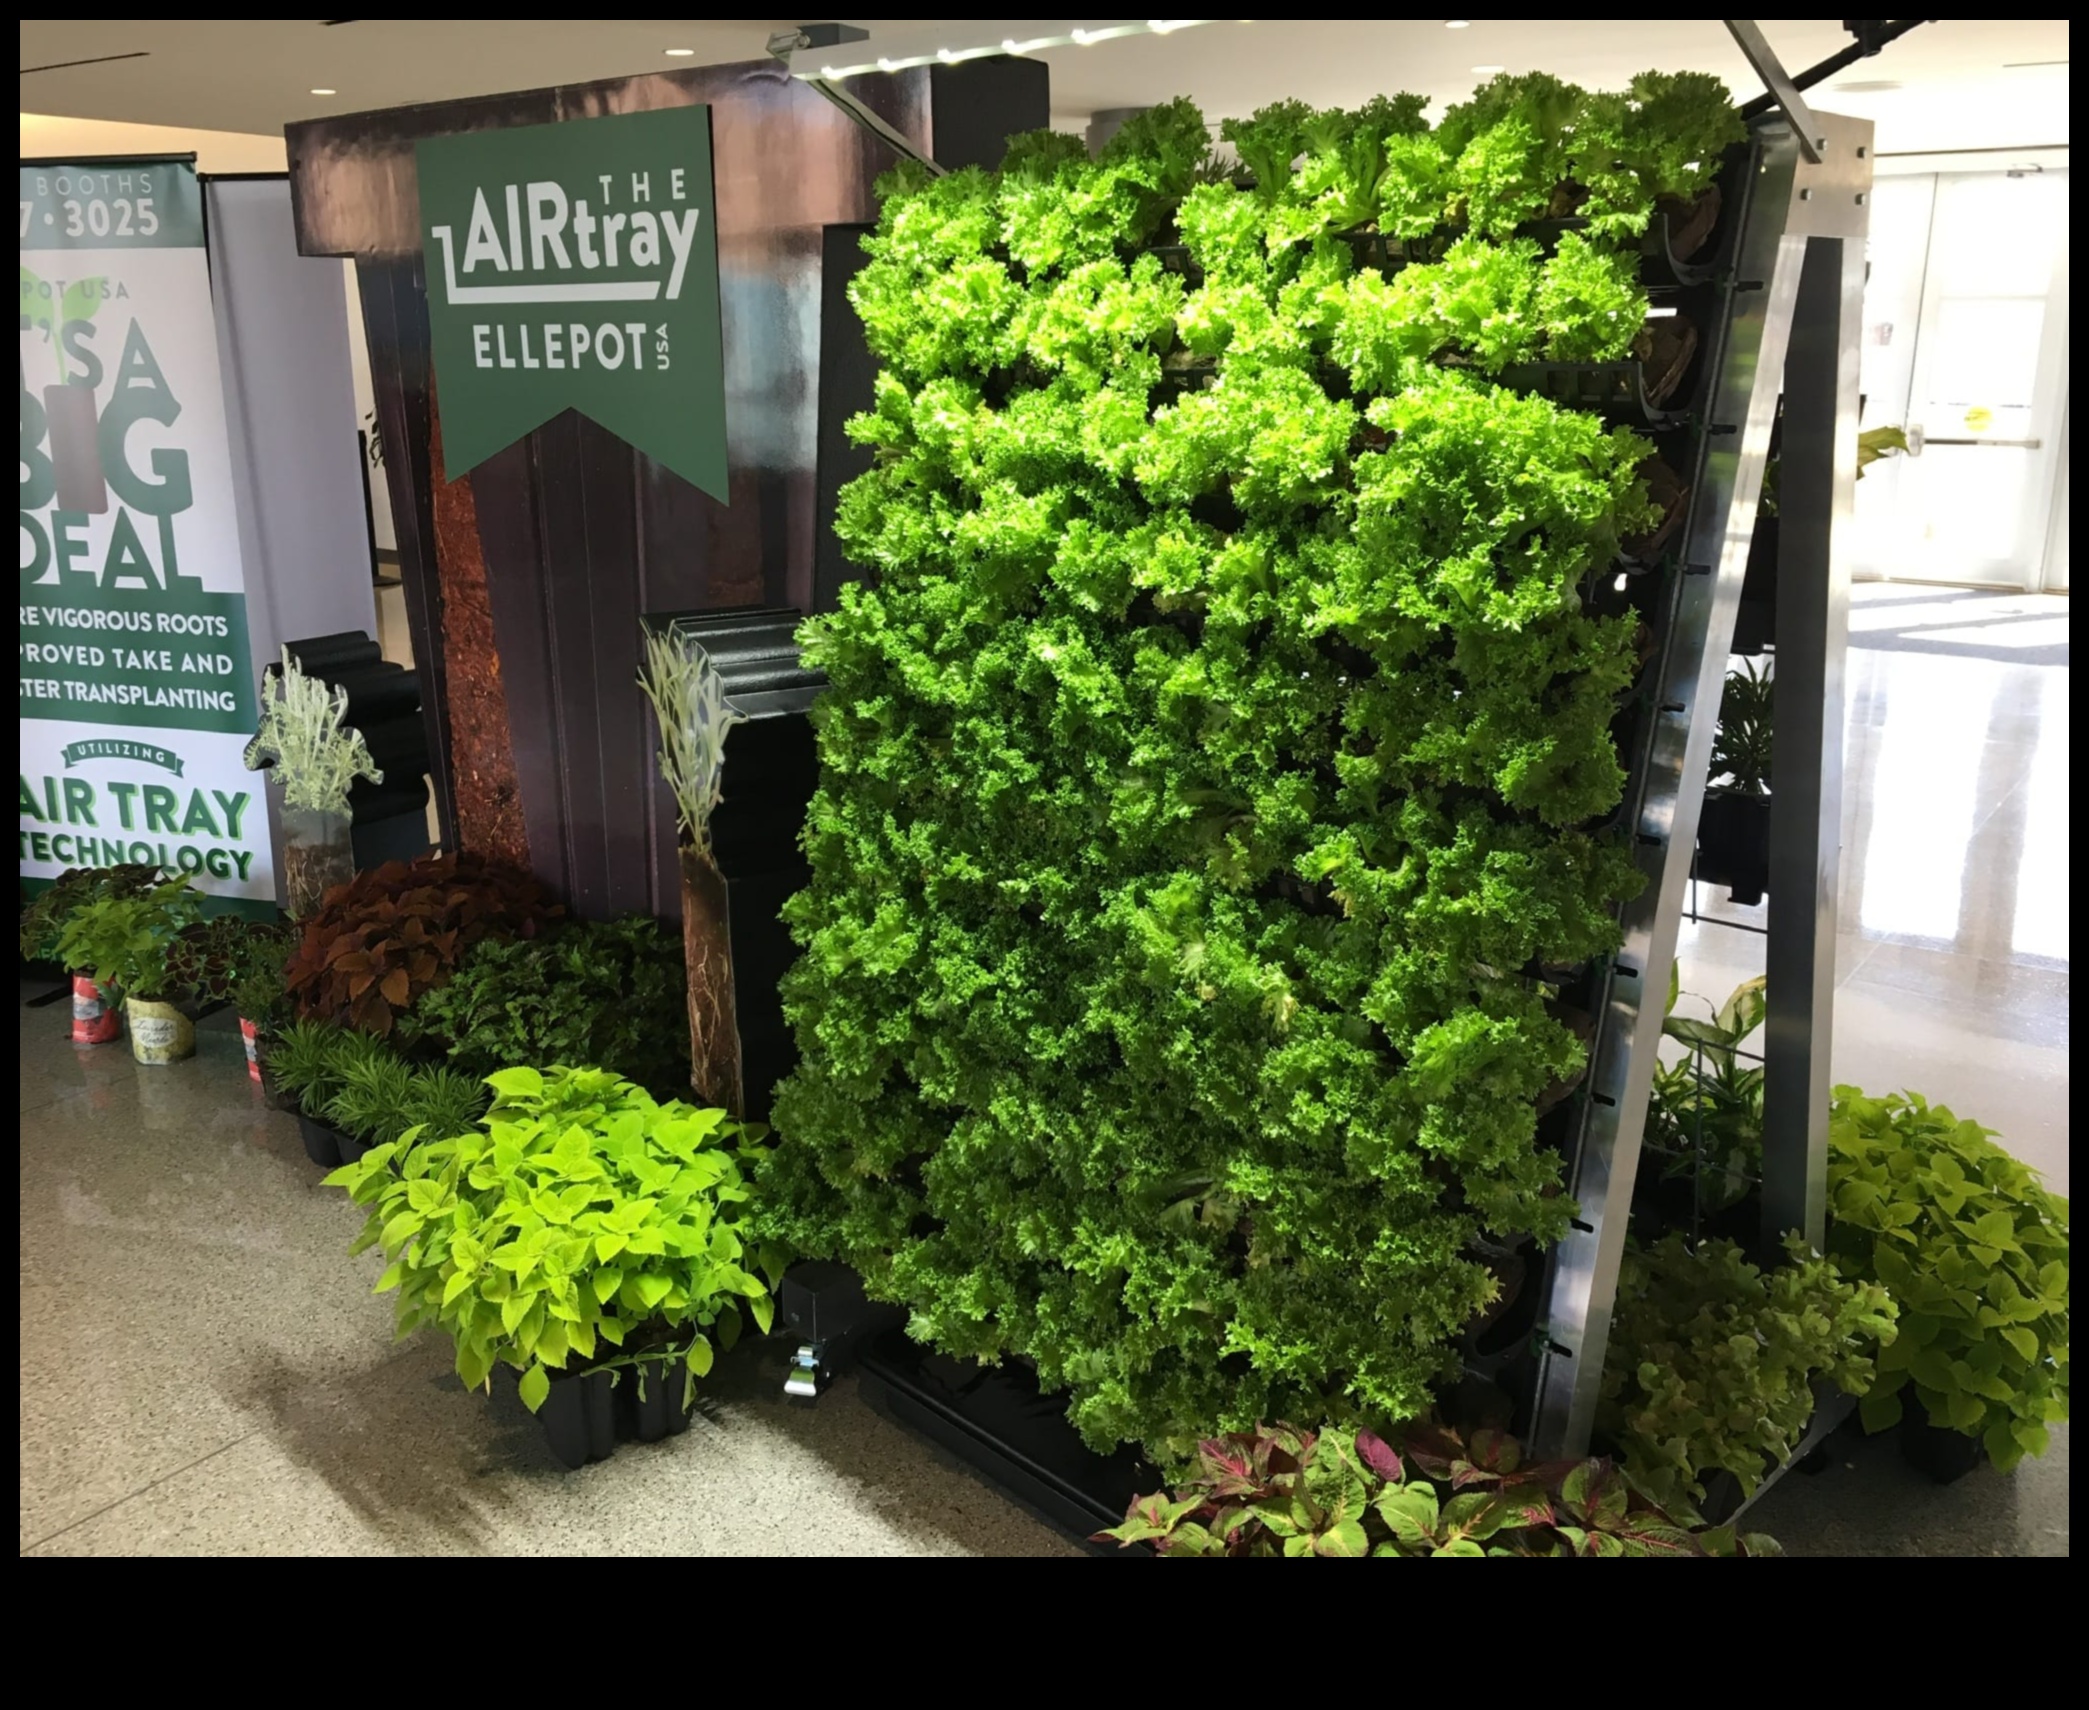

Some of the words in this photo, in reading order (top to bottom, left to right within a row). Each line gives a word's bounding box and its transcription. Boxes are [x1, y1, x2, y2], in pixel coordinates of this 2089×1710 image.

[36, 173, 152, 196] BOOTHS
[599, 168, 686, 205] THE
[63, 198, 159, 237] 3025
[462, 181, 699, 300] AIRtray
[80, 278, 130, 299] USA
[111, 316, 176, 401] A
[473, 322, 647, 370] ELLEPOT
[656, 322, 670, 370] USA
[20, 505, 203, 594] DEAL
[41, 606, 153, 632] VIGOROUS
[156, 612, 228, 637] ROOTS
[20, 643, 105, 667] ROVED
[111, 648, 173, 671] TAKE
[181, 652, 233, 675] AND
[20, 678, 61, 699] TER
[63, 680, 236, 712] TRANSPLANTING
[77, 743, 165, 762] UTILIZING
[20, 774, 98, 827] AIR
[107, 781, 251, 840] TRAY
